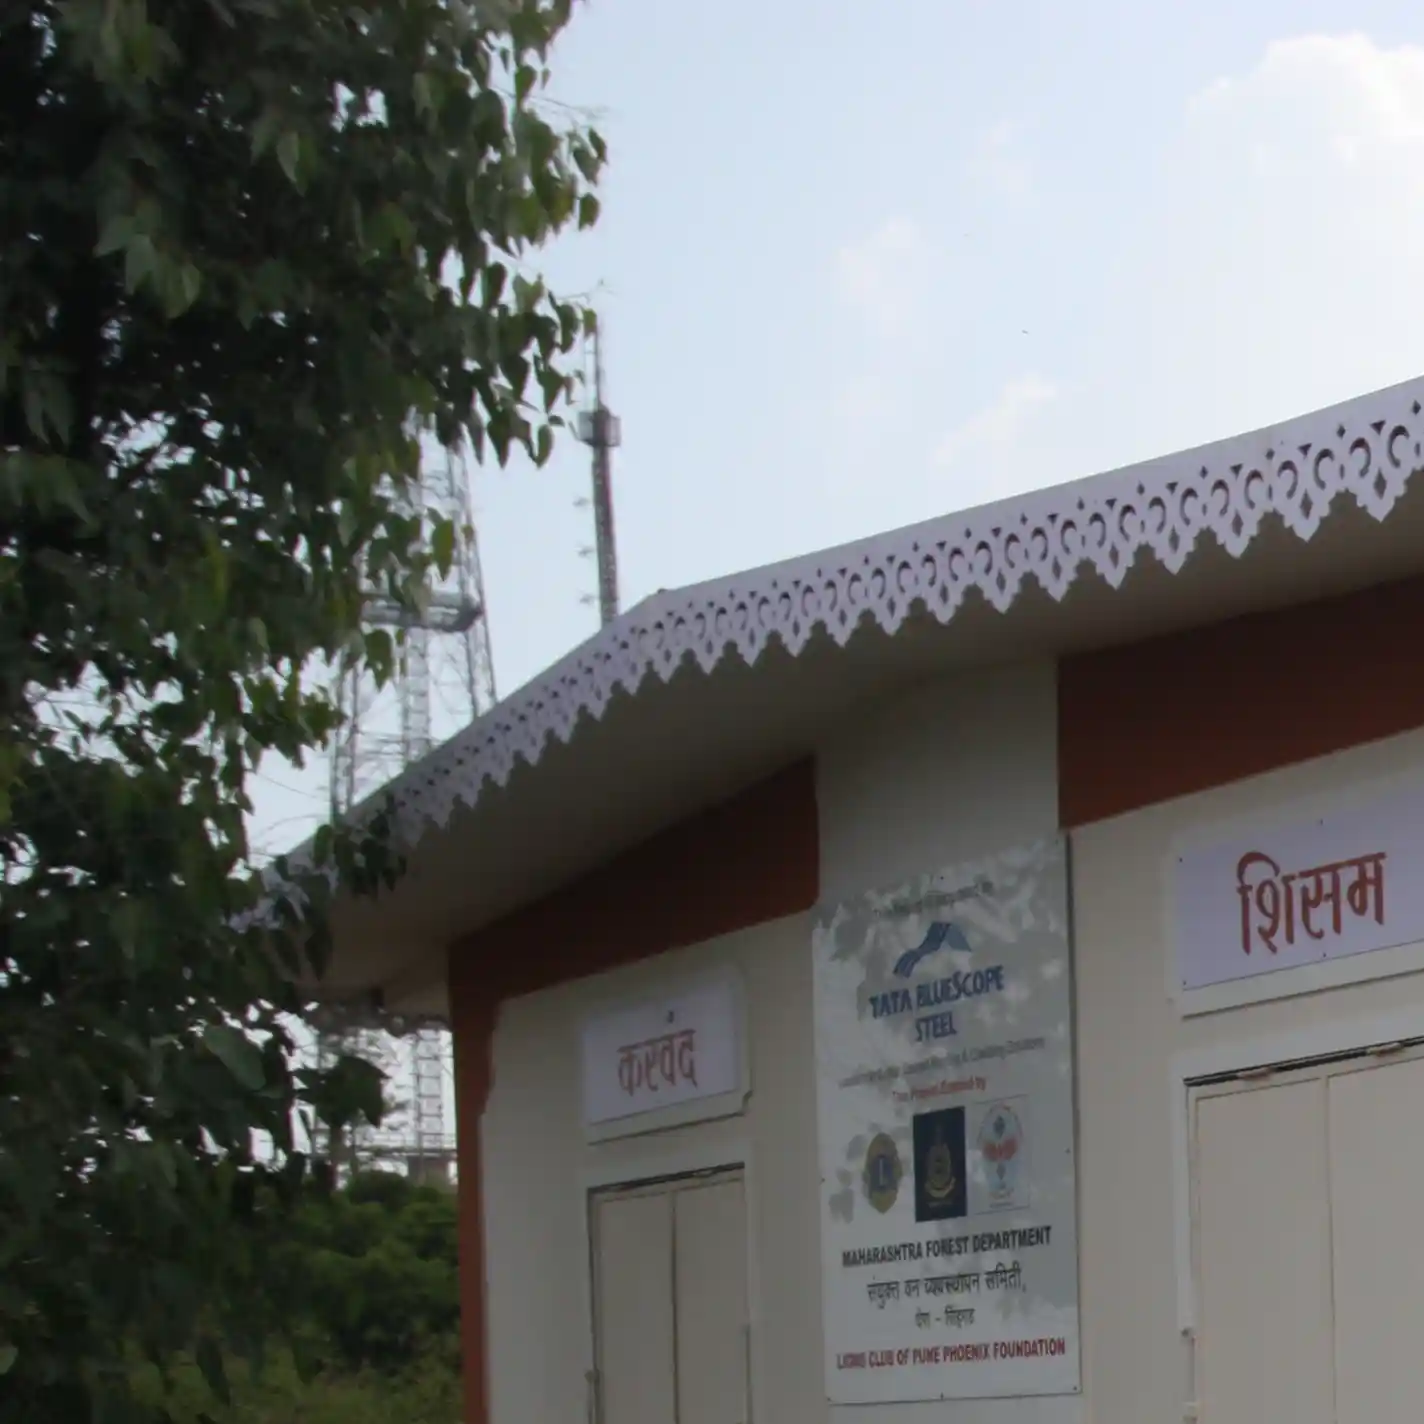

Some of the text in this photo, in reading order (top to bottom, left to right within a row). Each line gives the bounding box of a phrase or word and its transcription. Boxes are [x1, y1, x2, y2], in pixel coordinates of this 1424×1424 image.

[1236, 851, 1386, 955] शिसम
[869, 964, 1004, 1019] TATA BLUESCOPE
[916, 1011, 957, 1042] STEEL
[842, 1225, 1052, 1267] MAHARASHTRA FOREST DEPARTMENT
[868, 1349, 894, 1368] CLUB
[896, 1347, 909, 1366] OF
[913, 1345, 940, 1366] PUNE
[942, 1342, 989, 1362] PHOENIX
[993, 1338, 1065, 1360] FOUNDATION
